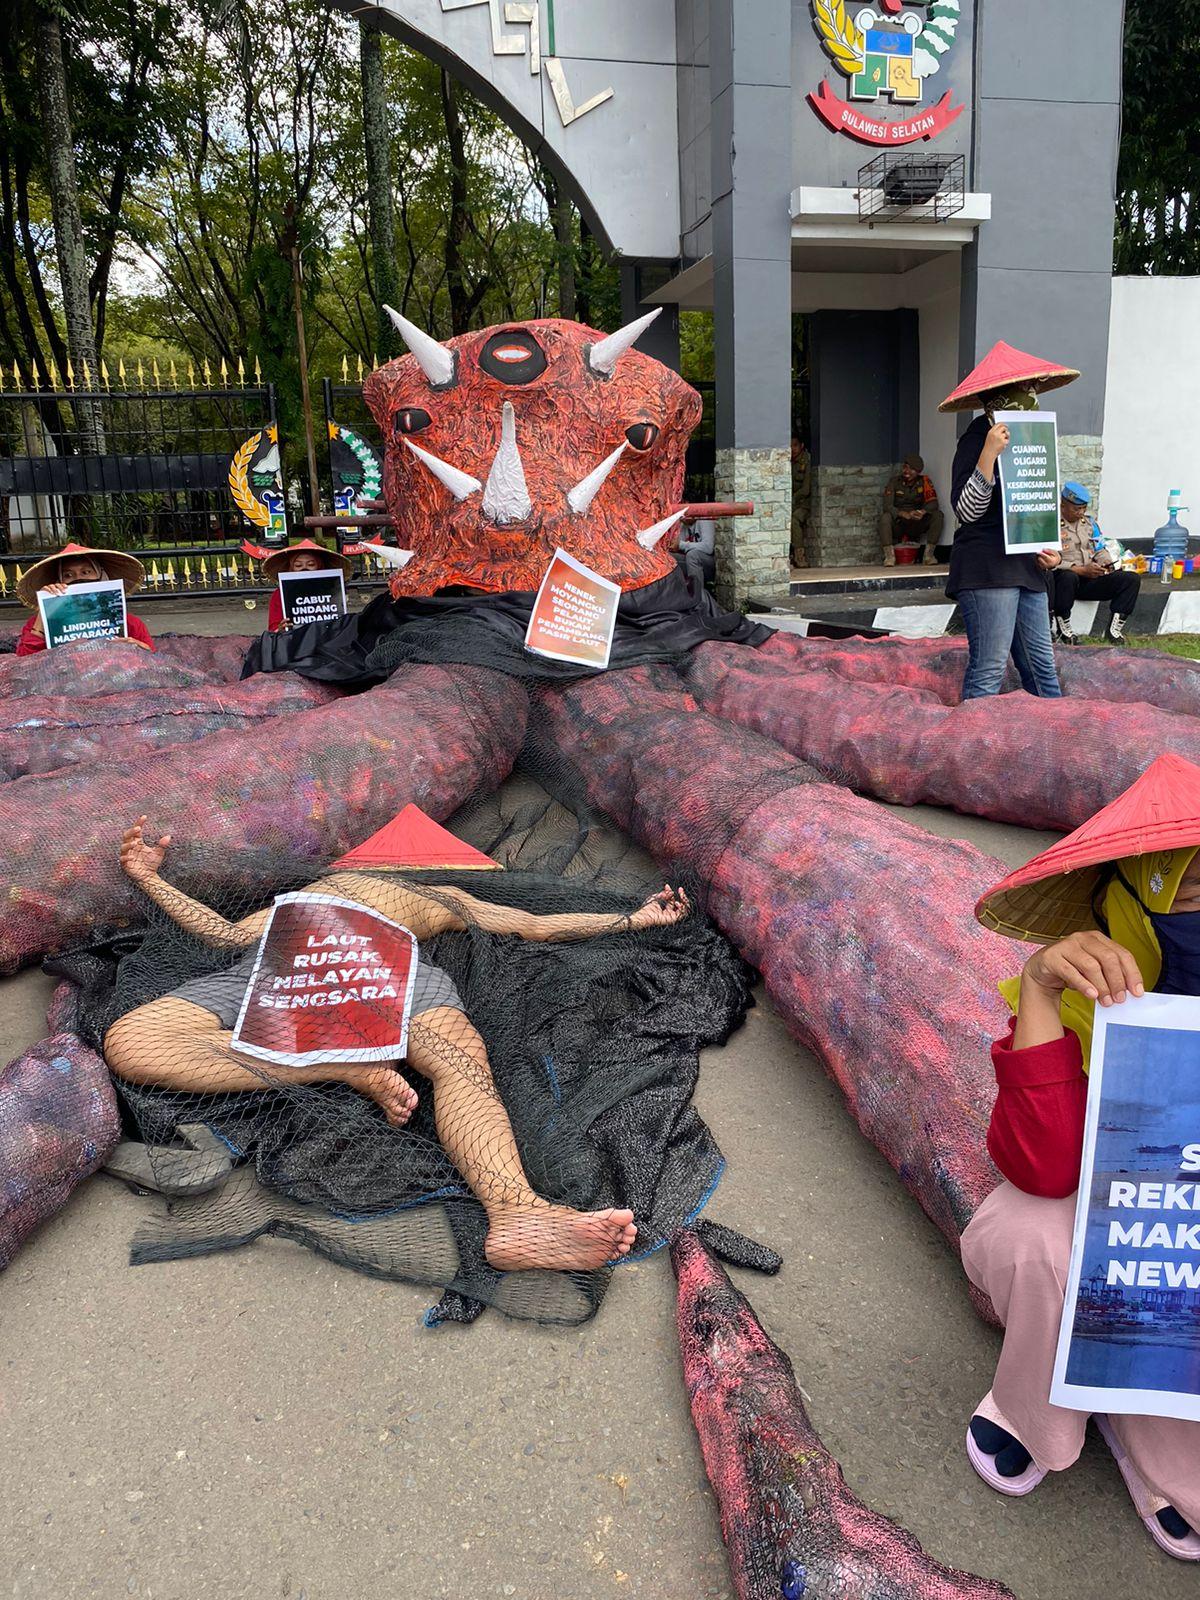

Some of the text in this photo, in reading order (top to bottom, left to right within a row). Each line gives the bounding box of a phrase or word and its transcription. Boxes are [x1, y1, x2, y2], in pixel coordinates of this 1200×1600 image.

[841, 110, 935, 138] SULAWESI SELATAN
[1012, 445, 1047, 454] CUANNYA
[1013, 457, 1047, 466] OLIGARKI
[1016, 468, 1046, 477] ADALAH
[1006, 480, 1055, 489] KESENGSARAAN
[1011, 491, 1053, 501] PEREMPUAN
[1008, 503, 1056, 513] KODINGARENG
[295, 595, 332, 605] CABUT
[550, 584, 606, 614] MOYANGKU
[564, 582, 597, 602] NENEK
[292, 604, 338, 615] UNDANG
[552, 596, 599, 620] SEORANG
[553, 606, 595, 626] PELAUT,
[63, 619, 110, 633] LINDUNGI
[537, 618, 605, 641] PENAMBANG
[554, 616, 592, 632] BUKAN
[54, 627, 120, 644] MASYARAKAT
[538, 626, 601, 647] PASIR LAUT
[307, 934, 373, 948] LAUT
[293, 951, 383, 969] RUSAK
[273, 967, 392, 990] NELAYAN
[257, 985, 399, 1010] SENGSARA
[1107, 1220, 1200, 1250] MAK
